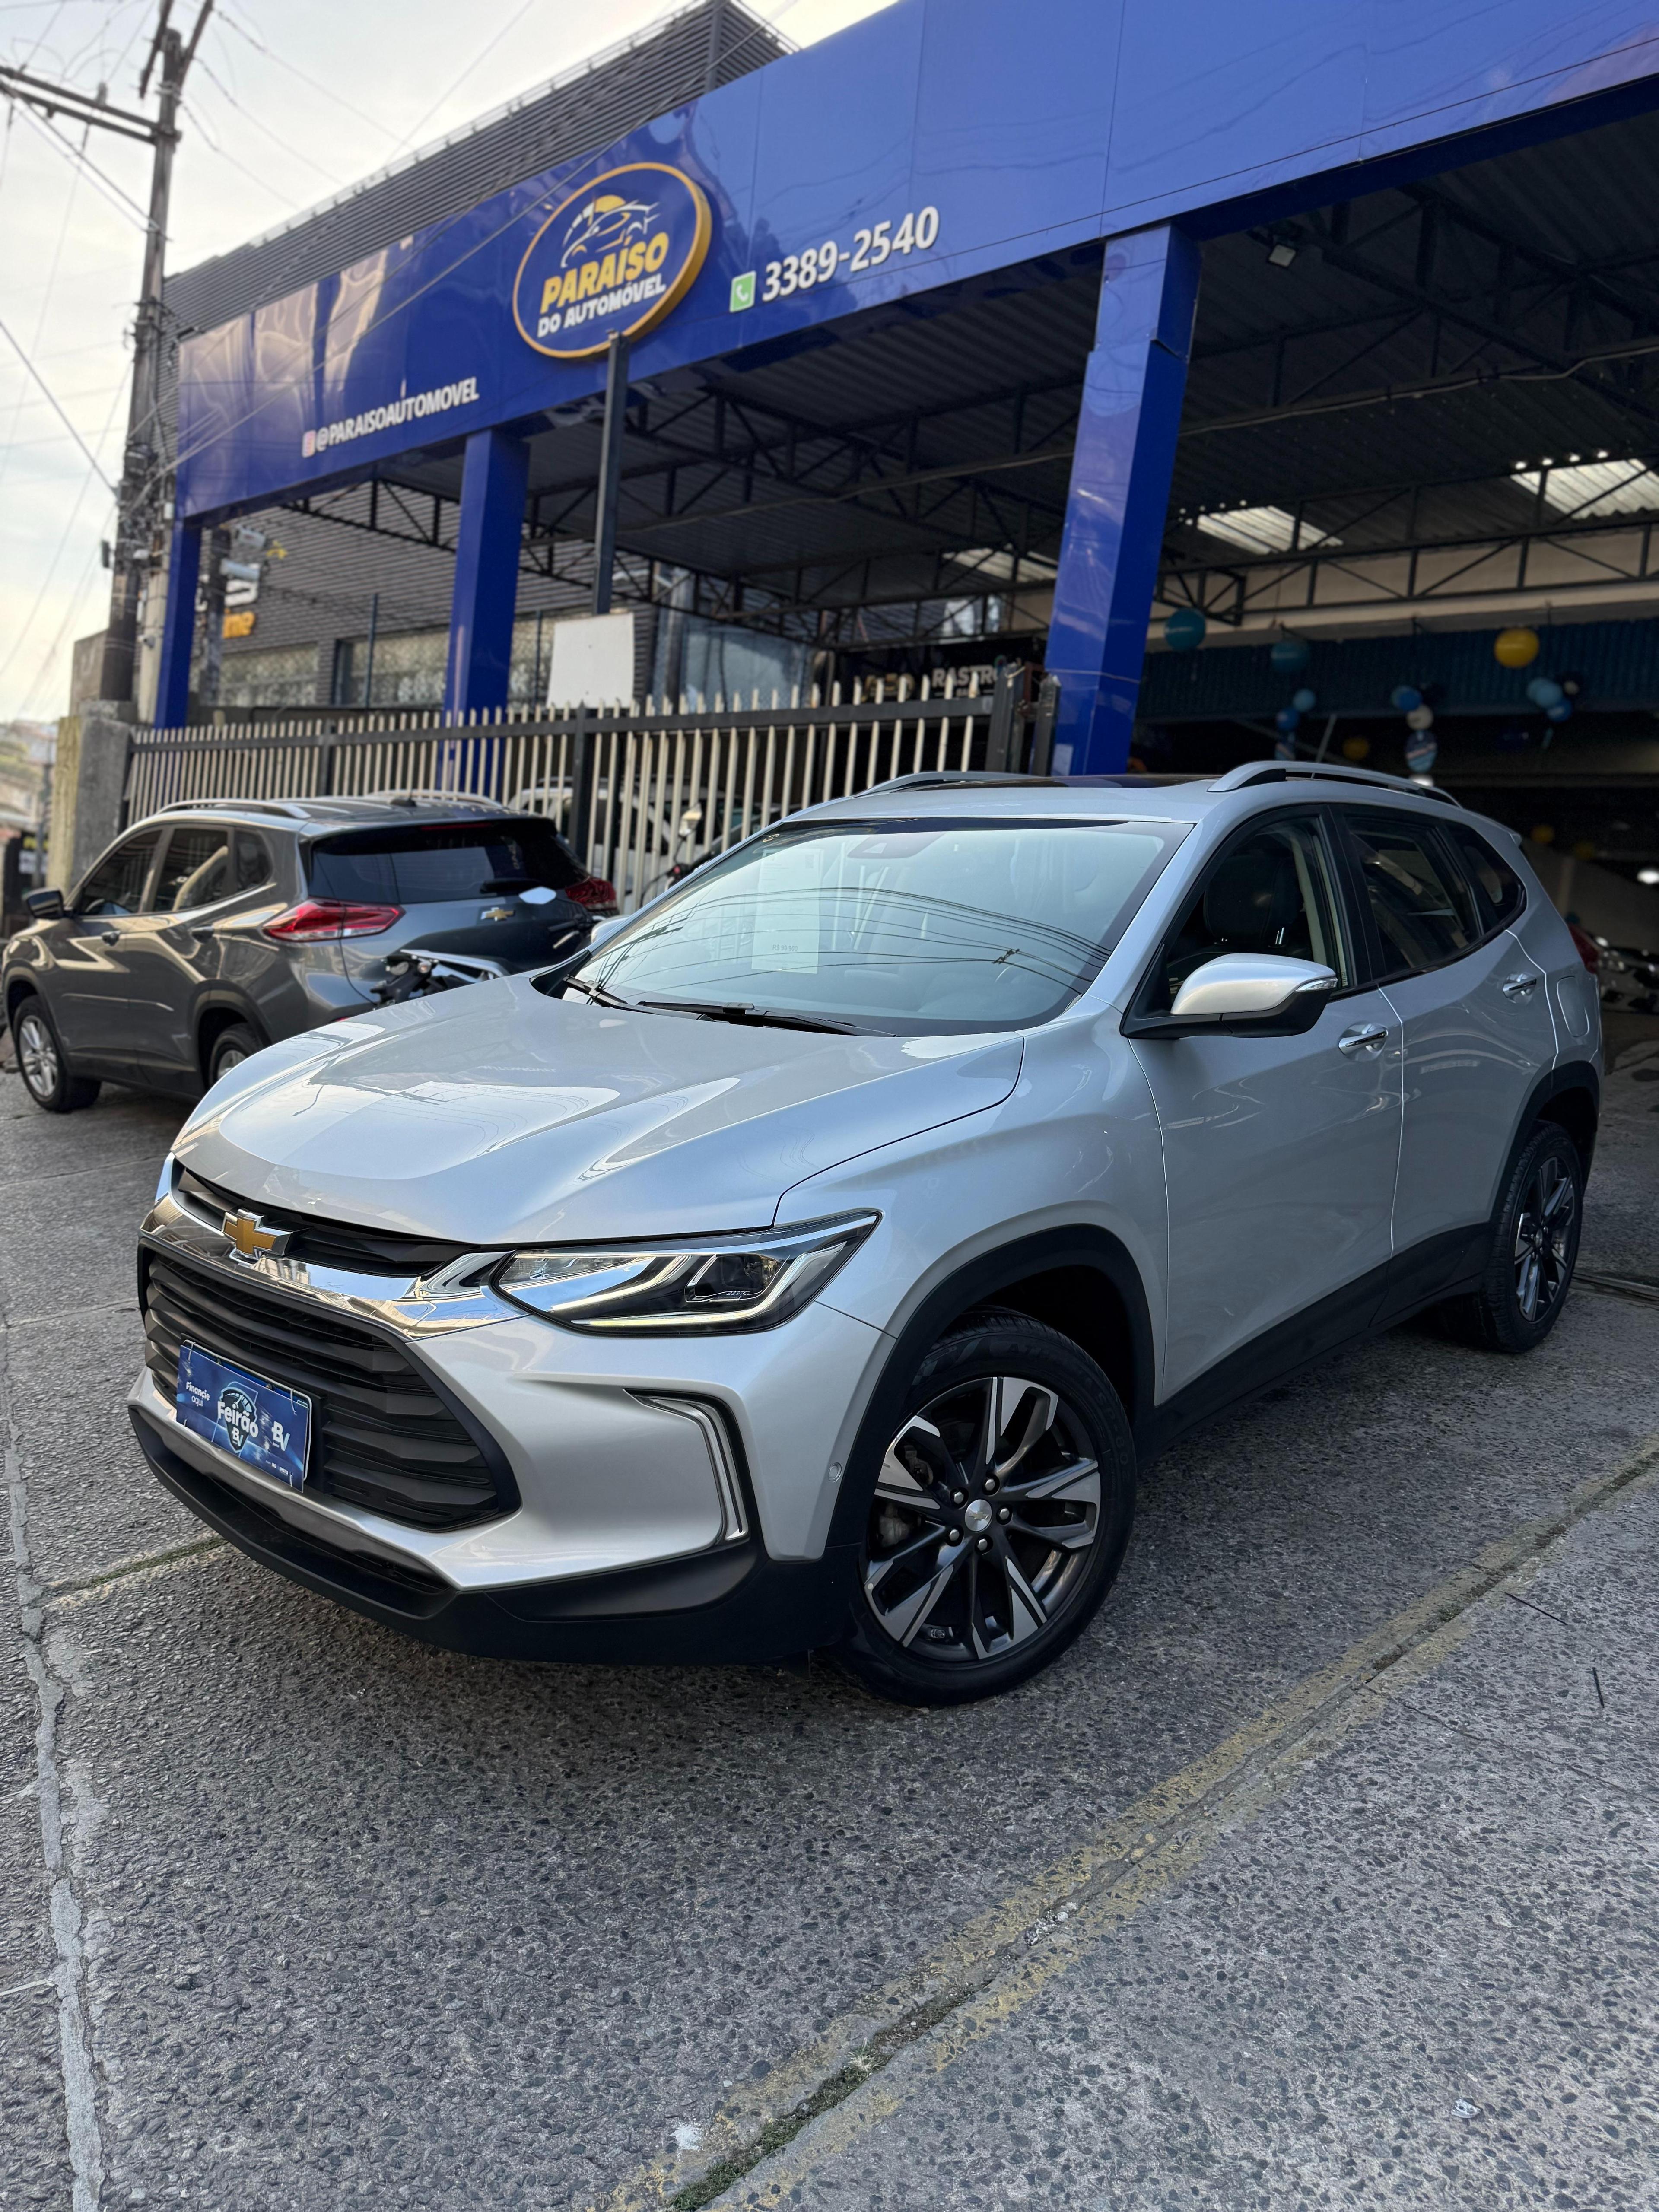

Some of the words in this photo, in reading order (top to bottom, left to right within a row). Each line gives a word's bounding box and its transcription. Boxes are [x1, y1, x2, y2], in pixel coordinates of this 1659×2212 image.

[540, 232, 669, 314] PARAÍSO
[762, 206, 940, 302] 3389-2540
[537, 313, 561, 338] DO
[563, 273, 667, 328] AUTOMÓVEL
[316, 377, 480, 452] @PARAISOAUTOMOVEL
[186, 1381, 210, 1401] Financie
[191, 1395, 203, 1407] aqui
[217, 1401, 259, 1438] Feirão
